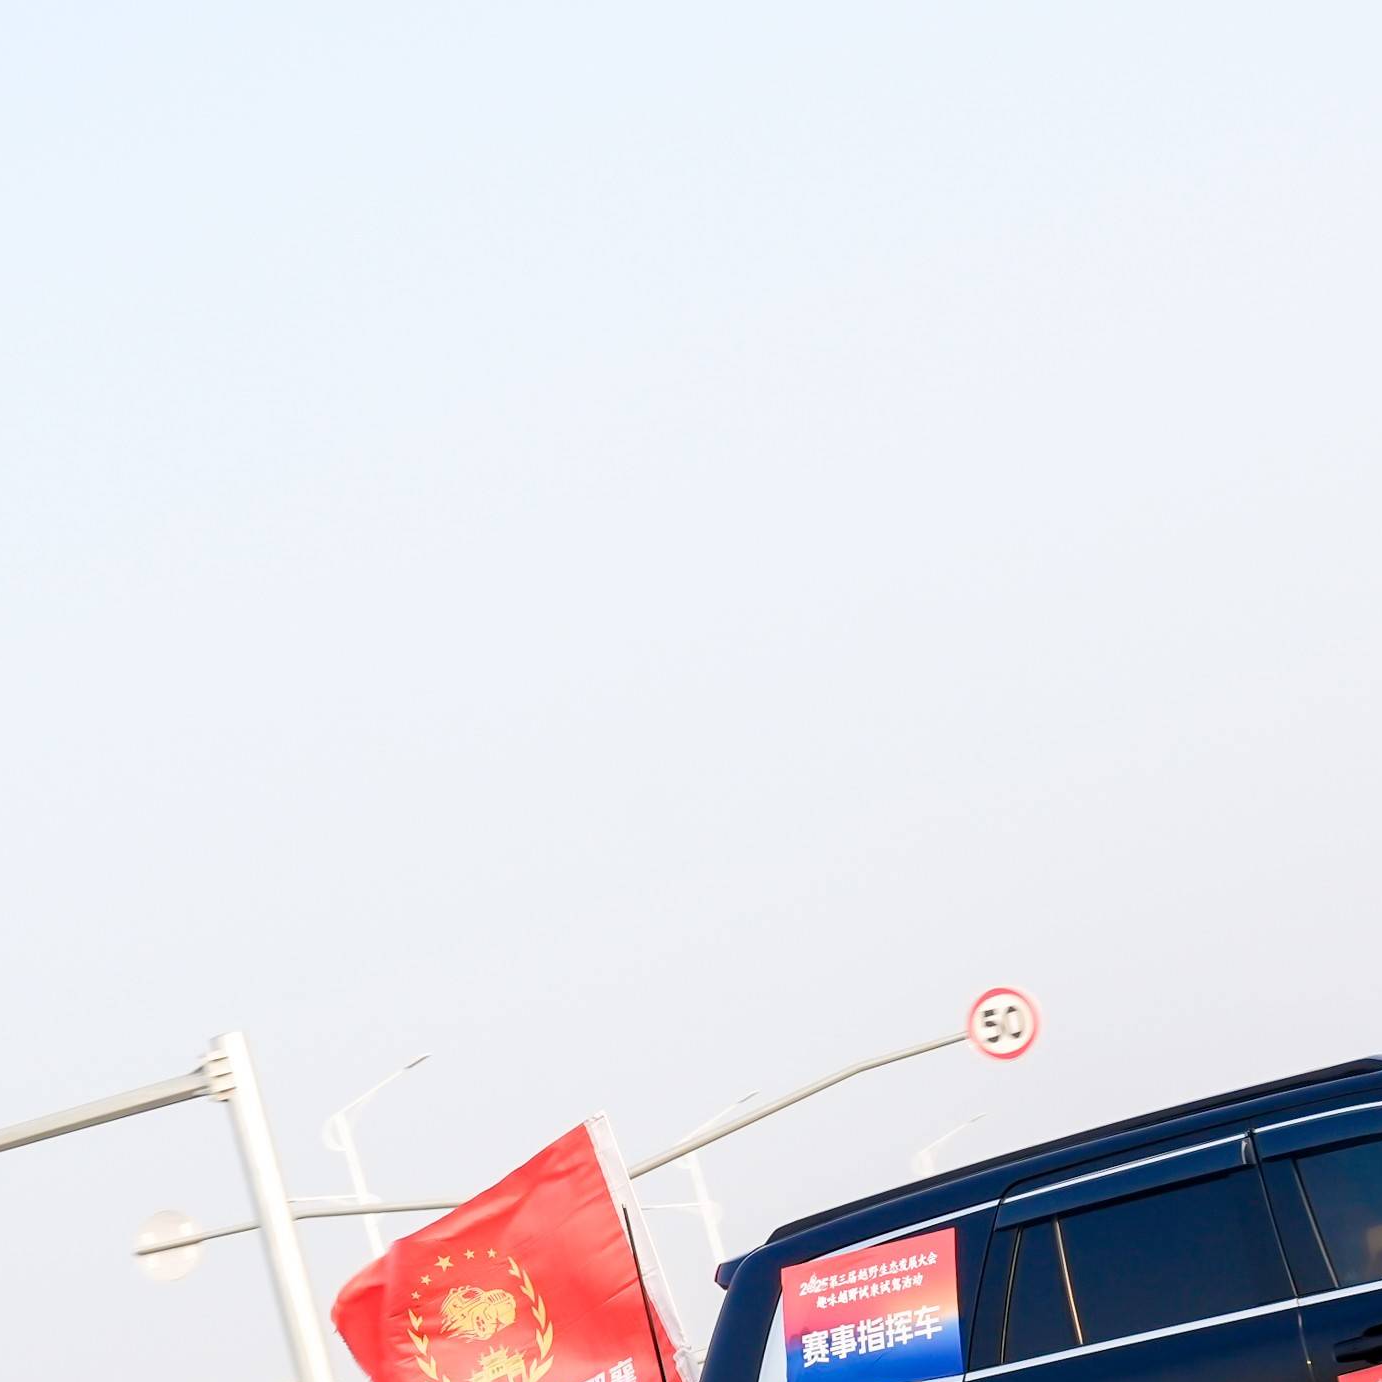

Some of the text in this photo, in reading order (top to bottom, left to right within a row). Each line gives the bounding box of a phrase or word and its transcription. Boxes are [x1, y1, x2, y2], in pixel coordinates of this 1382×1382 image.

[981, 1004, 1025, 1044] 50
[801, 1305, 943, 1368] 赛事指挥车
